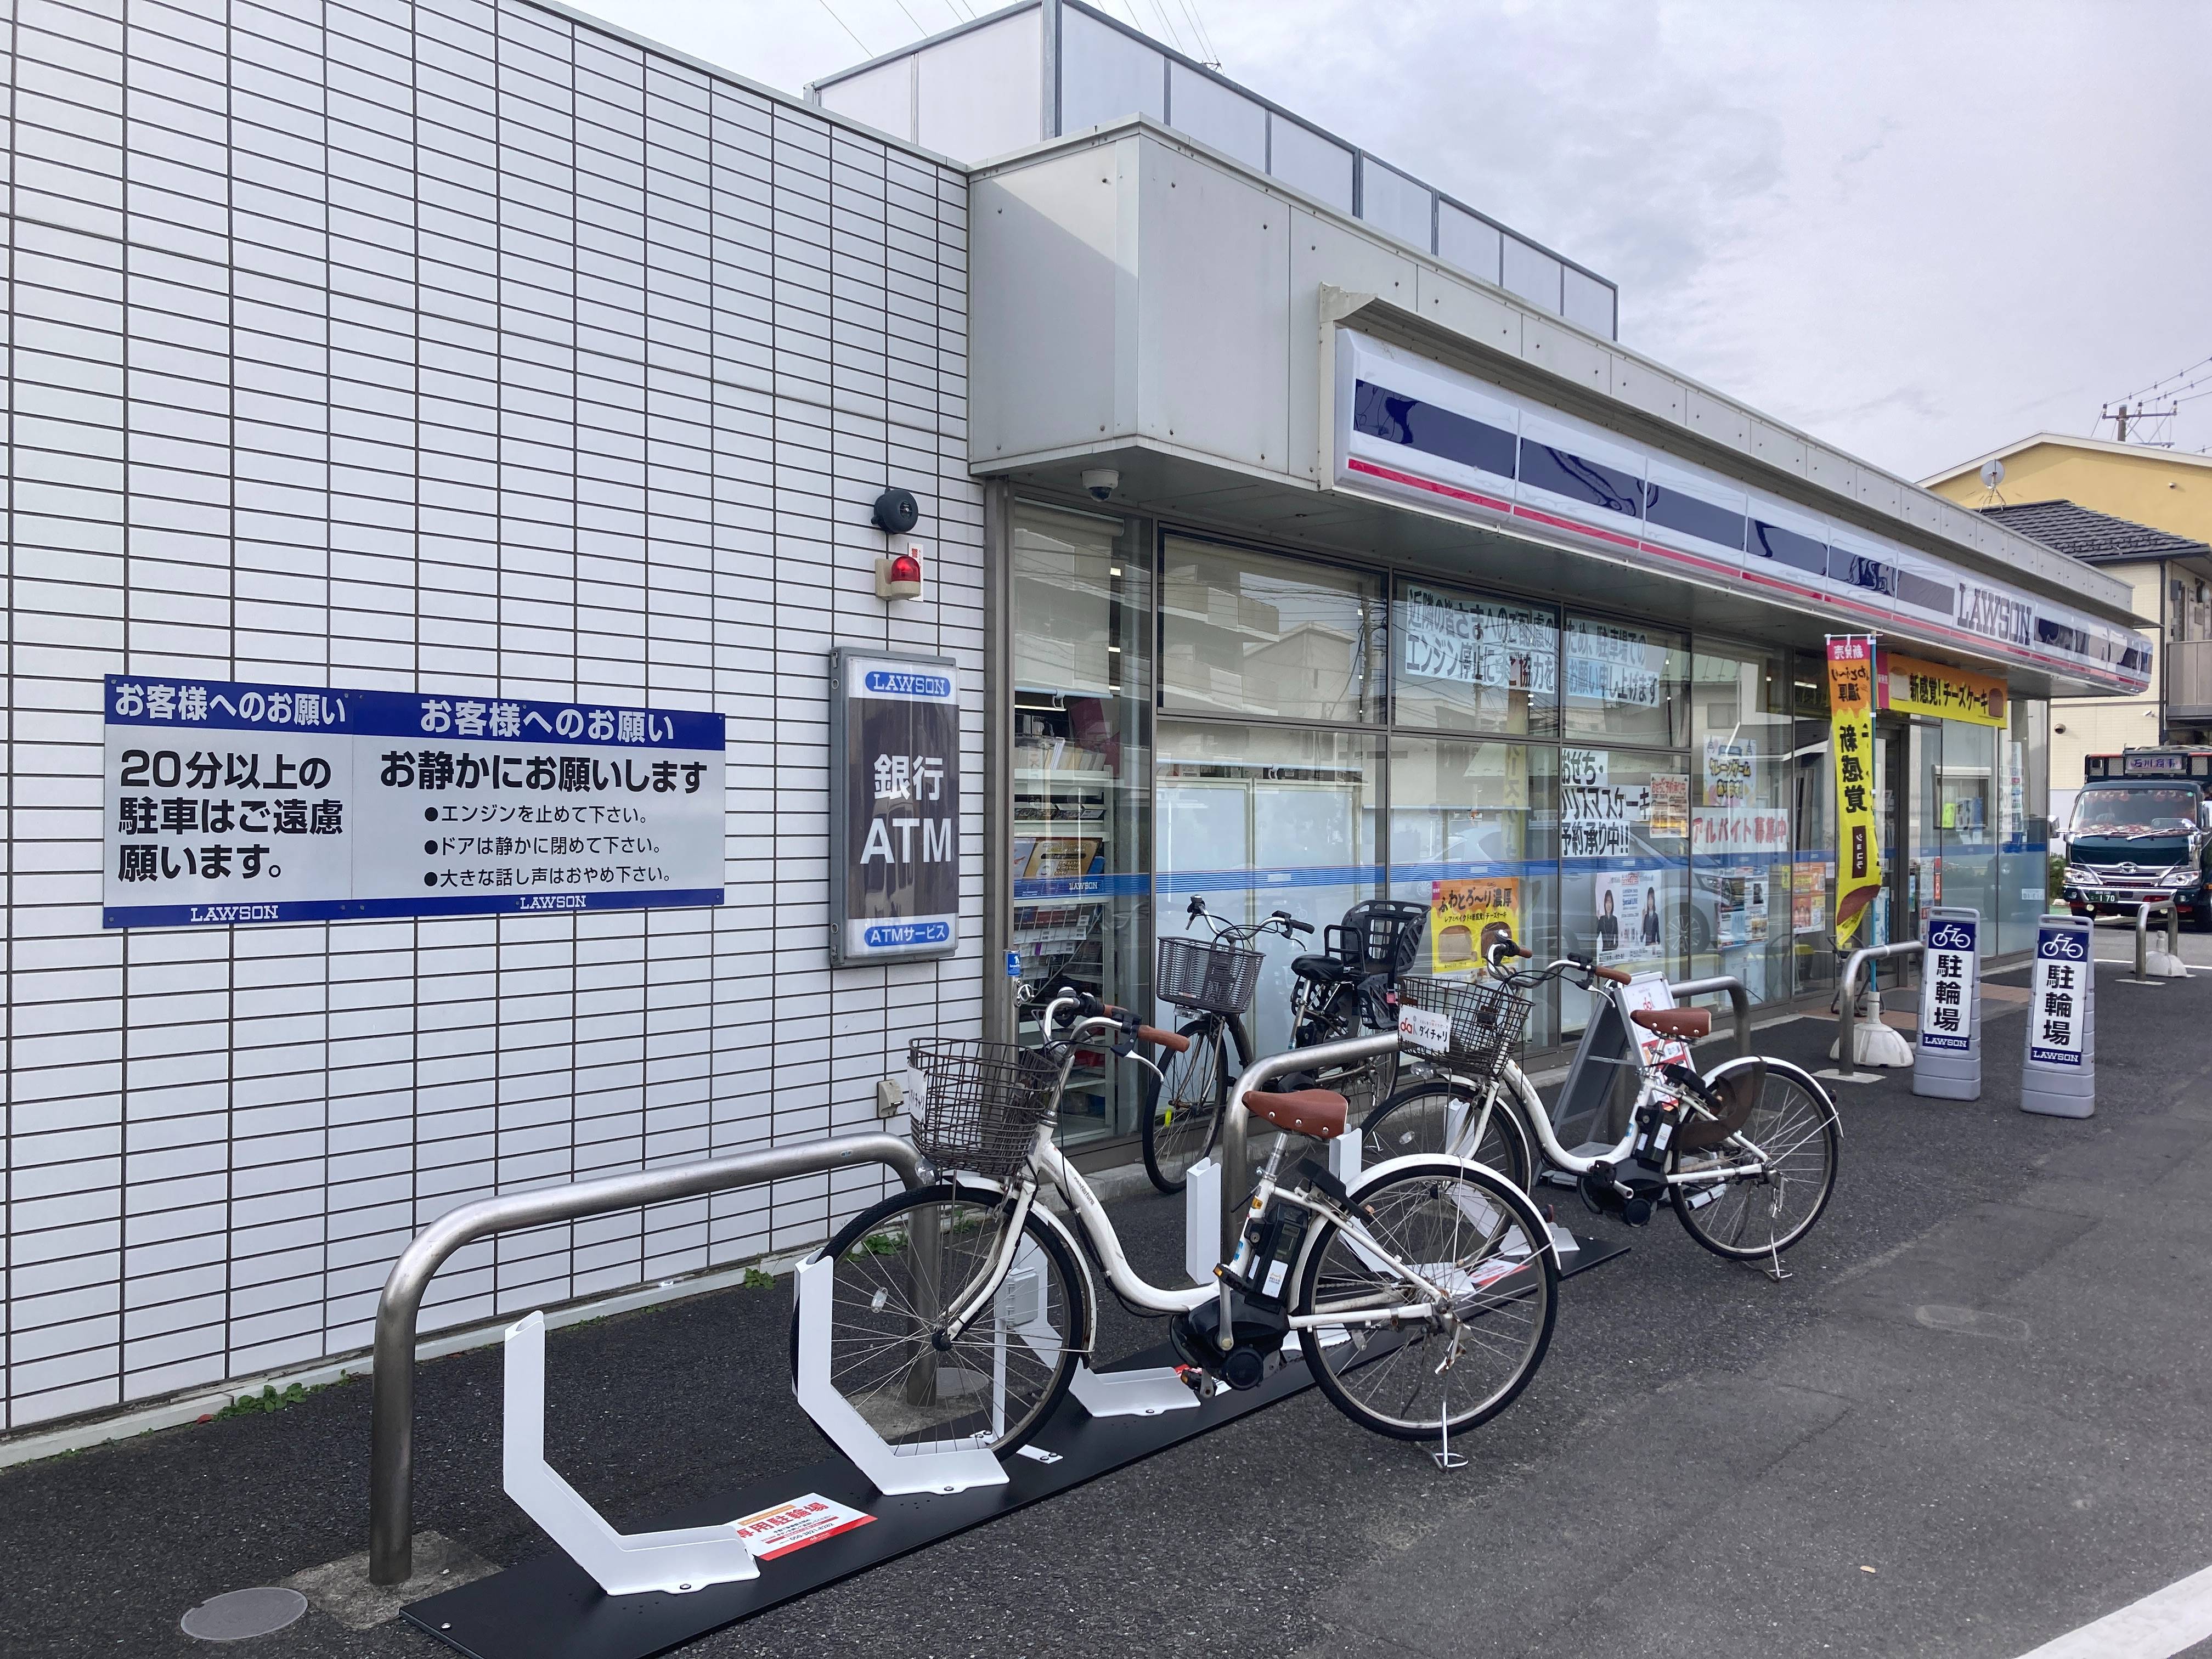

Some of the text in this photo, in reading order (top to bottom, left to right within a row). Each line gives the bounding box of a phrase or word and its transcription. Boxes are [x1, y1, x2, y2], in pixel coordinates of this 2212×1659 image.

[1957, 583, 2032, 645] LAWSON
[873, 674, 945, 695] LAWSON
[115, 683, 345, 726] お客様へのお願い
[420, 699, 674, 743] お客様へのお願い
[121, 749, 331, 789] 20分以上の
[381, 751, 707, 793] お静かにお願いします
[874, 754, 944, 800] 銀行
[119, 797, 343, 834] 駐車はご遠慮
[442, 804, 646, 823] エンジンを止めて下さい。
[1693, 816, 1787, 843] アルバイト募集中
[442, 836, 660, 856] ドアは静かに閉めて下さい。
[860, 818, 951, 864] ATM
[119, 844, 281, 882] 願います。
[441, 866, 670, 887] 大きな話し声はおやめ下さい。
[190, 905, 278, 921] LAWSON
[520, 895, 586, 910] LAWSON
[870, 924, 945, 943] ATMサービス
[1934, 955, 1962, 1031] 駐輪場
[2043, 964, 2075, 1045] 駐輪場
[1419, 1025, 1447, 1042] ダイチャリ
[1925, 1036, 1967, 1047] LAWSON
[2033, 1051, 2079, 1062] LAWSON
